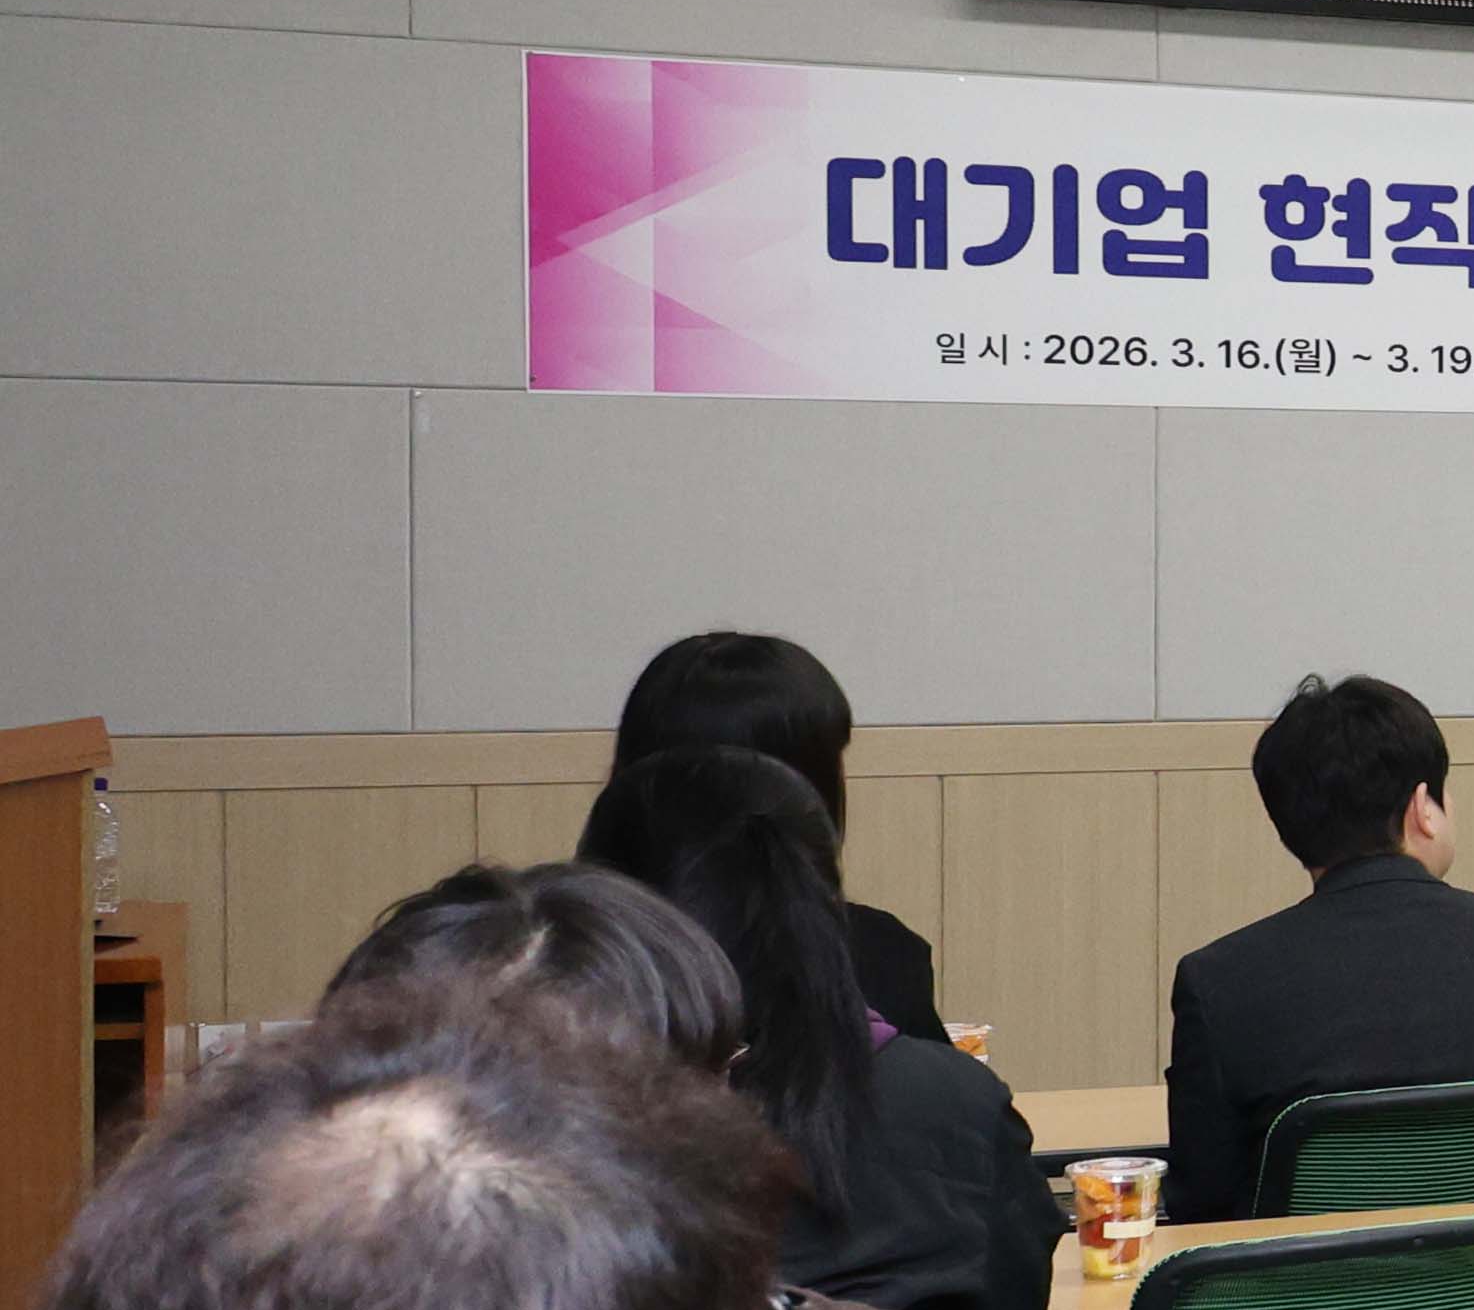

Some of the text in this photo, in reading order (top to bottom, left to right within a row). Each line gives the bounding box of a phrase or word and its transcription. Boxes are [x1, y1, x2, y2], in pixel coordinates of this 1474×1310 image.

[826, 156, 1210, 280] 대기업
[1043, 334, 1158, 367] 2026.
[1171, 337, 1205, 368] 3.
[1217, 338, 1336, 377] 16.(월)
[1387, 344, 1419, 373] 3.
